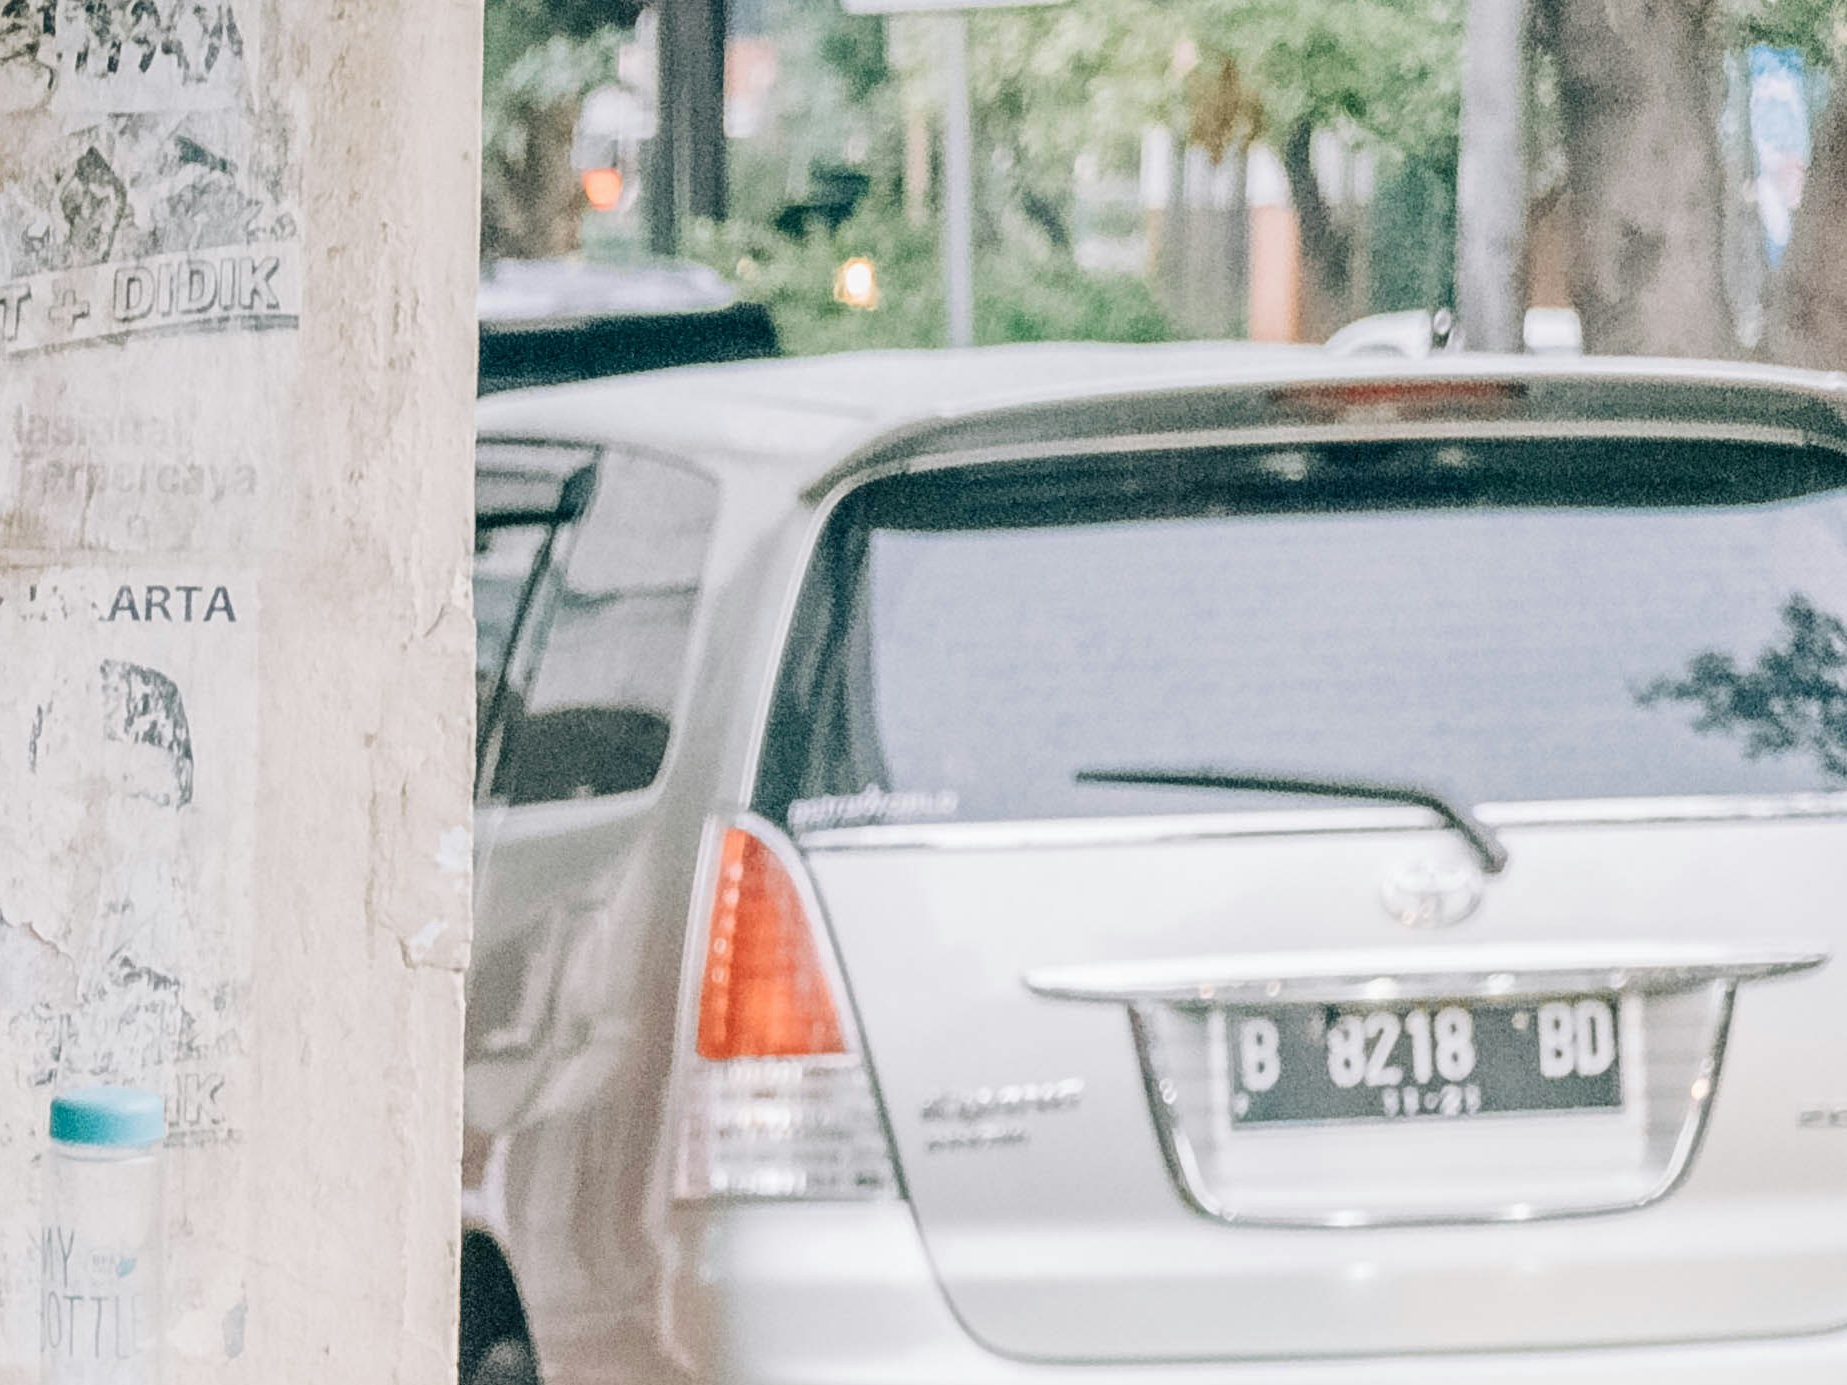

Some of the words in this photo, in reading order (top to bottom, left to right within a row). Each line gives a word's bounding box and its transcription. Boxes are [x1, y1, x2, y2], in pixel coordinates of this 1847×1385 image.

[113, 256, 281, 321] DIDIK
[22, 585, 237, 622] ARTA
[1241, 1018, 1281, 1091] B
[1327, 1007, 1476, 1088] 8218
